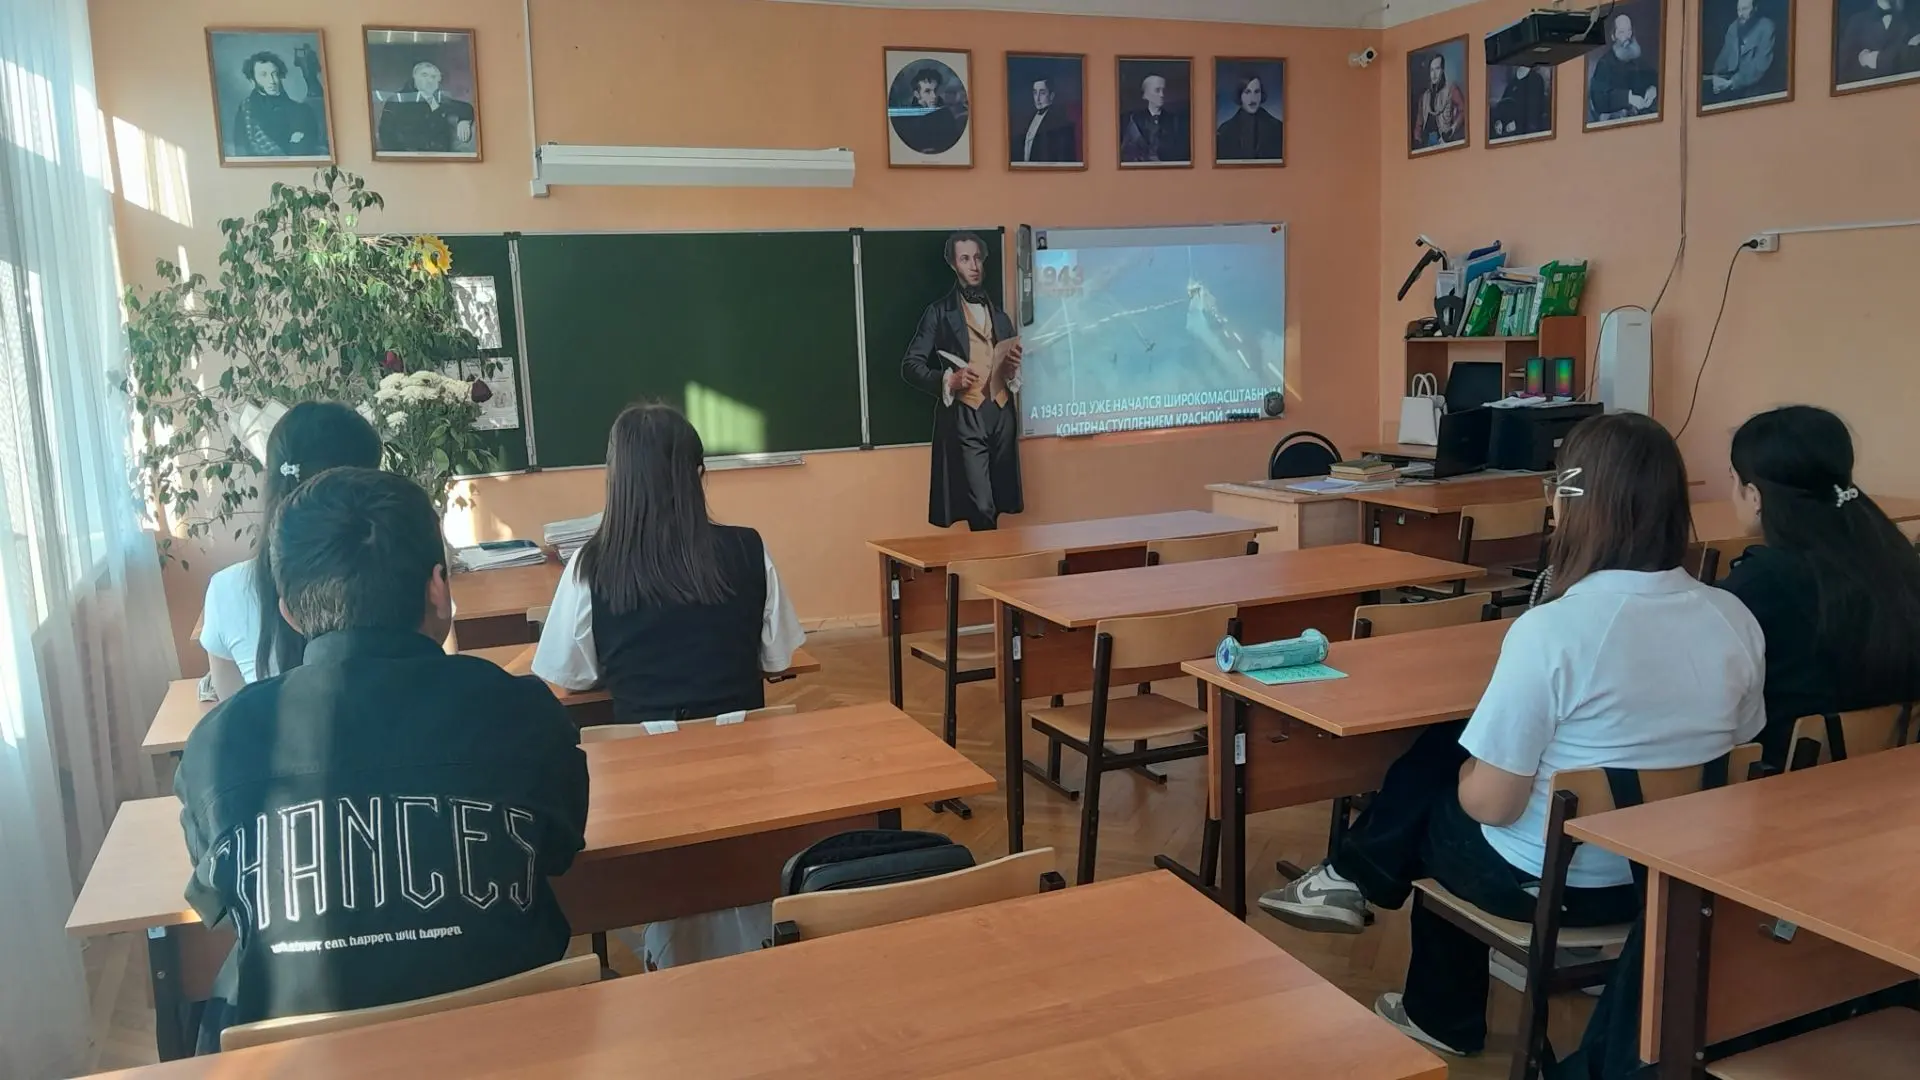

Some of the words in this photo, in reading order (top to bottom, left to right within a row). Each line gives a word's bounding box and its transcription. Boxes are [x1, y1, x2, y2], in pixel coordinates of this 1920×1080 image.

[1030, 406, 1039, 419] А
[1041, 403, 1063, 419] 1943
[1065, 401, 1087, 417] ГОД
[1089, 399, 1111, 414] УЖЕ
[1113, 395, 1161, 412] НАЧАЛСЯ
[1056, 415, 1173, 437] КОНТРНАСТУПЛЕНИЕМ
[1175, 407, 1222, 426] КРАСНОЙ
[324, 938, 348, 950] can
[349, 932, 394, 946] happen
[395, 929, 417, 941] will
[419, 925, 462, 939] happen
